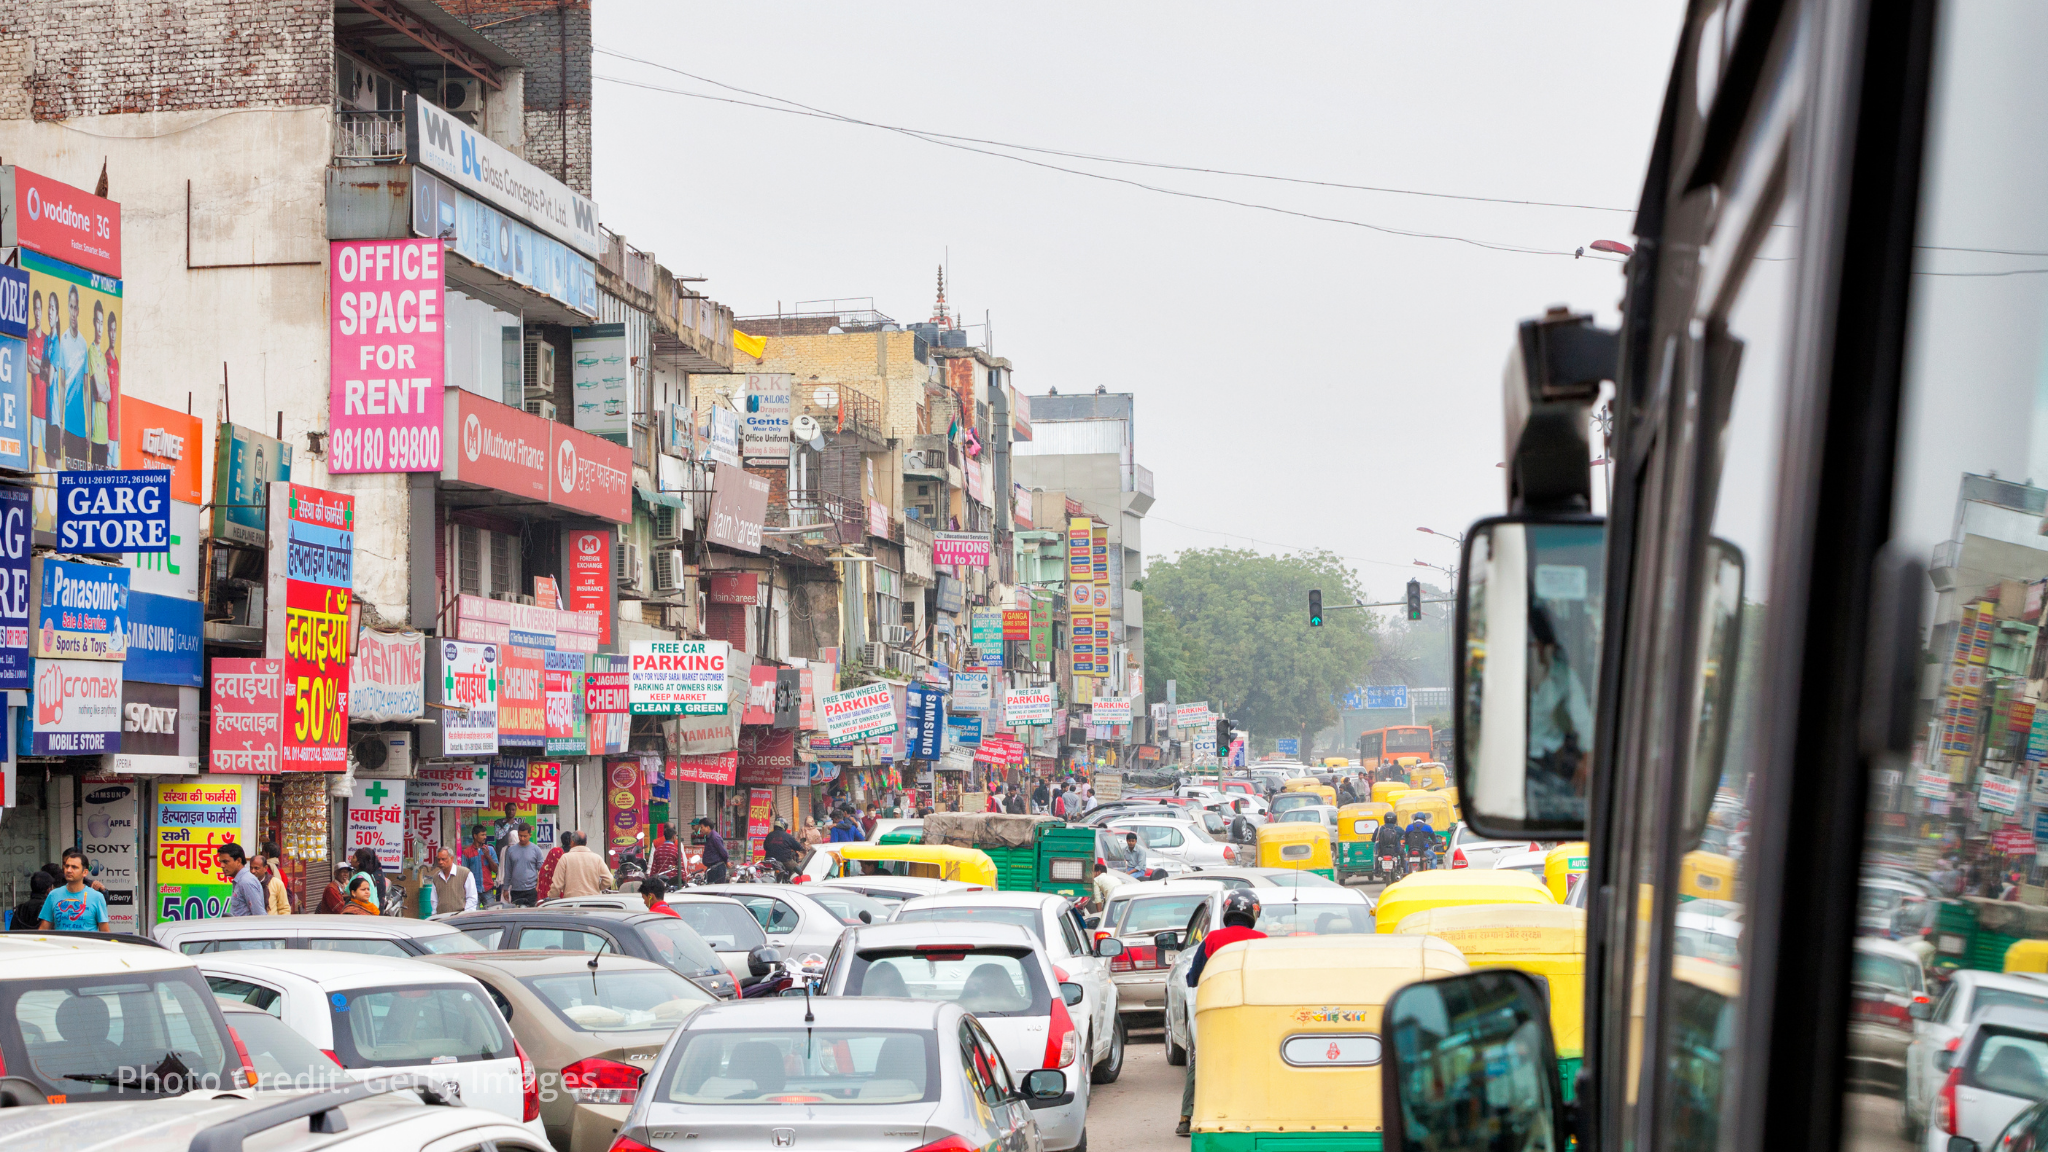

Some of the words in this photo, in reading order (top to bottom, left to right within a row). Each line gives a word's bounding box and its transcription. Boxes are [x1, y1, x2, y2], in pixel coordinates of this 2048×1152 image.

[482, 156, 504, 192] Glass
[504, 168, 539, 214] Concepts
[540, 189, 555, 221] Pvt.
[555, 198, 568, 228] Ltd.
[43, 200, 90, 232] vodafone
[97, 214, 110, 239] 3G
[71, 239, 83, 251] Faster.
[84, 243, 98, 255] Smarter.
[98, 248, 110, 260] Better.
[338, 244, 438, 282] OFFICE
[100, 278, 117, 293] YONEX
[339, 289, 437, 335] SPACE
[360, 344, 416, 370] FOR
[344, 378, 431, 415] RENT
[758, 395, 790, 404] TAILORS
[760, 406, 788, 414] Drapers
[746, 417, 789, 425] Gents
[333, 427, 384, 470] 98180
[389, 425, 440, 469] 99800
[745, 434, 764, 442] Office
[764, 434, 788, 443] Uniform
[483, 427, 517, 463] Muthoot
[517, 438, 544, 471] Finance
[62, 476, 76, 484] PH.
[78, 476, 131, 485] 011-26197137,
[132, 475, 166, 484] 26194064
[578, 456, 596, 494] मुथूट
[68, 486, 161, 515] GARG
[299, 495, 314, 520] संस्था
[315, 497, 324, 520] की
[61, 520, 167, 548] STORE
[944, 532, 969, 540] Educational
[935, 541, 988, 554] TUITIONS
[940, 554, 952, 564] VI
[954, 554, 966, 564] to
[968, 554, 984, 565] XII
[54, 566, 119, 611] Panasonic
[730, 592, 756, 603] Sarees
[462, 598, 484, 617] BLINDS
[1007, 611, 1027, 619] GANGA
[62, 612, 76, 629] Sale
[78, 614, 82, 629] &
[84, 614, 106, 630] Service
[460, 618, 485, 639] CARPETS
[513, 606, 519, 628] R.
[520, 607, 526, 628] K.
[526, 608, 556, 632] OVERSEAS
[974, 620, 989, 628] LOWEST
[990, 620, 1001, 628] PRICE
[126, 622, 174, 652] SAMSUNG
[178, 634, 199, 652] GALAXY
[286, 589, 348, 672] दवाईयाँ
[56, 635, 80, 655] Sports
[82, 637, 88, 652] &
[90, 638, 107, 656] Toys
[651, 643, 679, 653] FREE
[682, 643, 705, 653] CAR
[360, 636, 421, 686] RENTING
[568, 654, 584, 670] CHEMIST
[633, 655, 724, 671] PARKING
[214, 661, 279, 704] दवाईयाँ
[455, 658, 486, 708] दवाईयाँ
[504, 666, 539, 700] CHEMIST
[633, 673, 644, 681] ONLY
[644, 673, 653, 681] FOR
[653, 673, 667, 681] YUSUF
[668, 673, 680, 681] SARAI
[681, 673, 698, 681] MARKET
[699, 673, 724, 681] CUSTOMERS
[634, 683, 664, 691] PARKING
[666, 683, 675, 691] AT
[676, 683, 705, 691] OWNERS
[706, 683, 723, 691] RISK
[822, 694, 839, 705] FREE
[840, 692, 854, 700] TWO
[856, 684, 887, 696] WHEELER
[587, 689, 629, 710] CHEMI
[633, 704, 670, 712] CLEAN
[674, 704, 682, 712] &
[685, 704, 723, 712] GREEN
[825, 692, 889, 716] PARKING
[1007, 695, 1050, 704] PARKING
[124, 702, 177, 734] SONY
[295, 676, 340, 744] 50%
[499, 706, 518, 729] ANUJA
[520, 708, 544, 730] MEDICOS
[1178, 706, 1207, 715] PARKING
[214, 704, 278, 736] हैल्पलाइन
[842, 726, 857, 734] KEEP
[859, 720, 882, 730] MARKET
[922, 694, 936, 756] SAMSUNG
[49, 733, 78, 750] MOBILE
[80, 734, 105, 750] STORE
[680, 726, 732, 742] YAMAHA
[833, 734, 858, 744] CLEAN
[869, 725, 896, 736] GREEN
[116, 759, 132, 768] XPERIA
[213, 741, 277, 772] फार्मेसी
[418, 766, 474, 781] दवाईयाँ
[494, 770, 524, 779] MEDICOS
[90, 790, 126, 799] SAMSUNG
[163, 789, 187, 802] संस्था
[190, 788, 202, 802] की
[205, 789, 237, 802] फार्मेसी
[441, 783, 464, 791] 50%
[162, 806, 204, 825] हैल्पलाइन
[206, 807, 237, 824] फार्मेसी
[350, 803, 401, 824] दवाईयाँ
[162, 828, 190, 841] सभी
[355, 831, 385, 846] 50%
[86, 844, 130, 854] SONY
[1505, 928, 1518, 938] और
[630, 1053, 657, 1062] CITY
